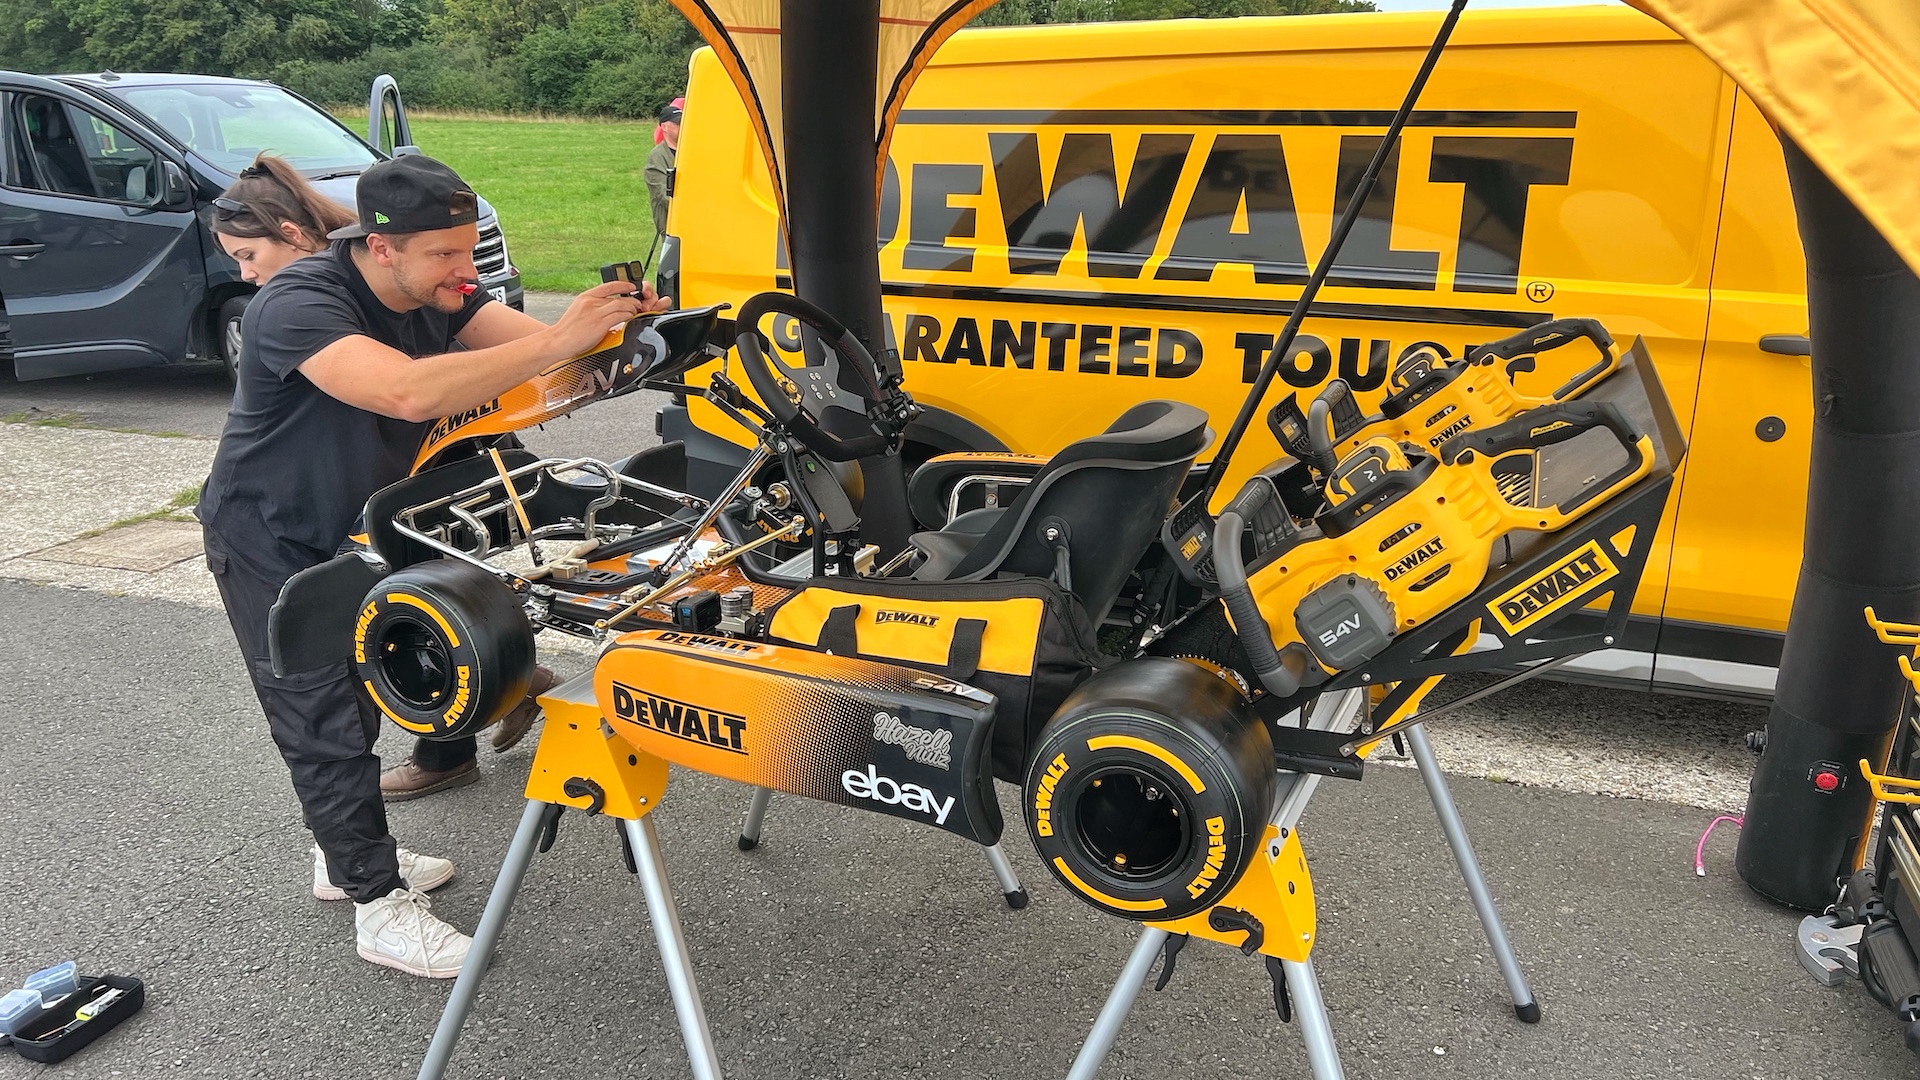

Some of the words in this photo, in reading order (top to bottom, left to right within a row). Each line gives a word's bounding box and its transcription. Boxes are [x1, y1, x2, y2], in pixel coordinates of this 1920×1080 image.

[776, 133, 1574, 295] EWALT
[772, 312, 1203, 380] GRANTEED
[1235, 332, 1480, 392] TOU
[1429, 415, 1473, 448] DEWALT
[1384, 537, 1445, 582] DEWALT
[1499, 551, 1602, 624] DEWALT
[354, 600, 379, 664] DEWALT
[655, 632, 760, 655] DEWALT
[875, 610, 939, 627] DEWALT
[1318, 613, 1361, 648] 54V
[442, 665, 471, 728] DEWALT
[612, 685, 746, 750] DEWALT
[841, 764, 956, 825] ebay
[1035, 752, 1070, 837] DEWALT
[1186, 815, 1227, 900] DEWALT
